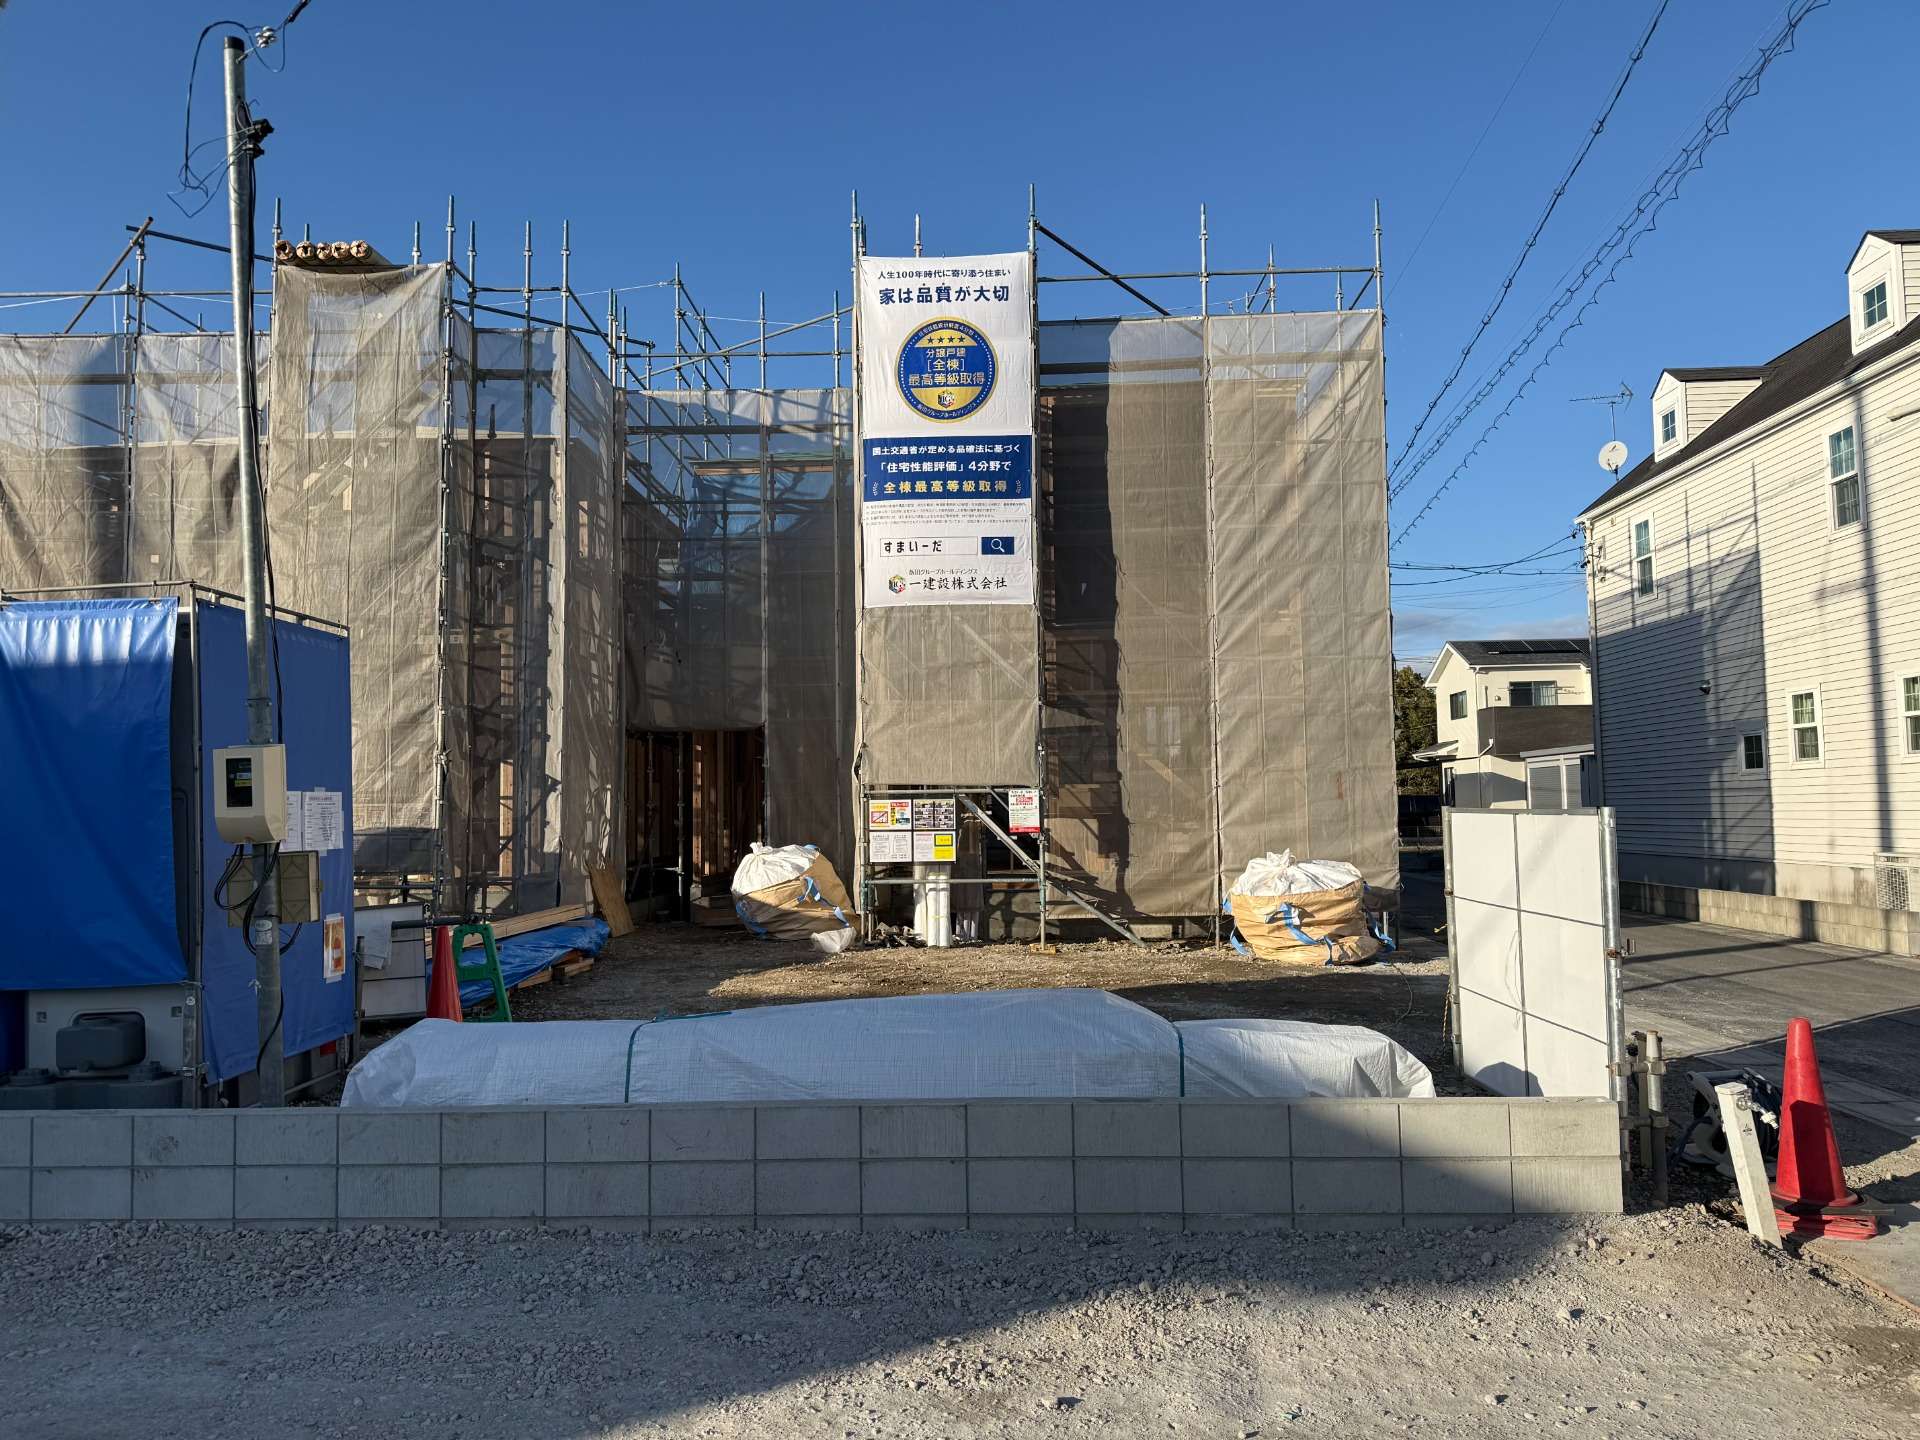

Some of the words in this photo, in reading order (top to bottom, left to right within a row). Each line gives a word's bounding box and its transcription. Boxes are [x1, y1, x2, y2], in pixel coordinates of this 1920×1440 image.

[878, 269, 1010, 279] 人生100年時代に寄り添う住まい
[879, 285, 1009, 305] 家は品質が大切
[926, 347, 966, 358] 分譲戸建
[908, 372, 985, 386] 最高等級取得
[872, 444, 1020, 456] 国土交通省が定める品確法に基づく
[884, 480, 1007, 494] 全棟最高等級取得
[883, 539, 943, 554] すまいーだ
[909, 576, 1008, 590] 一建設株式会社
